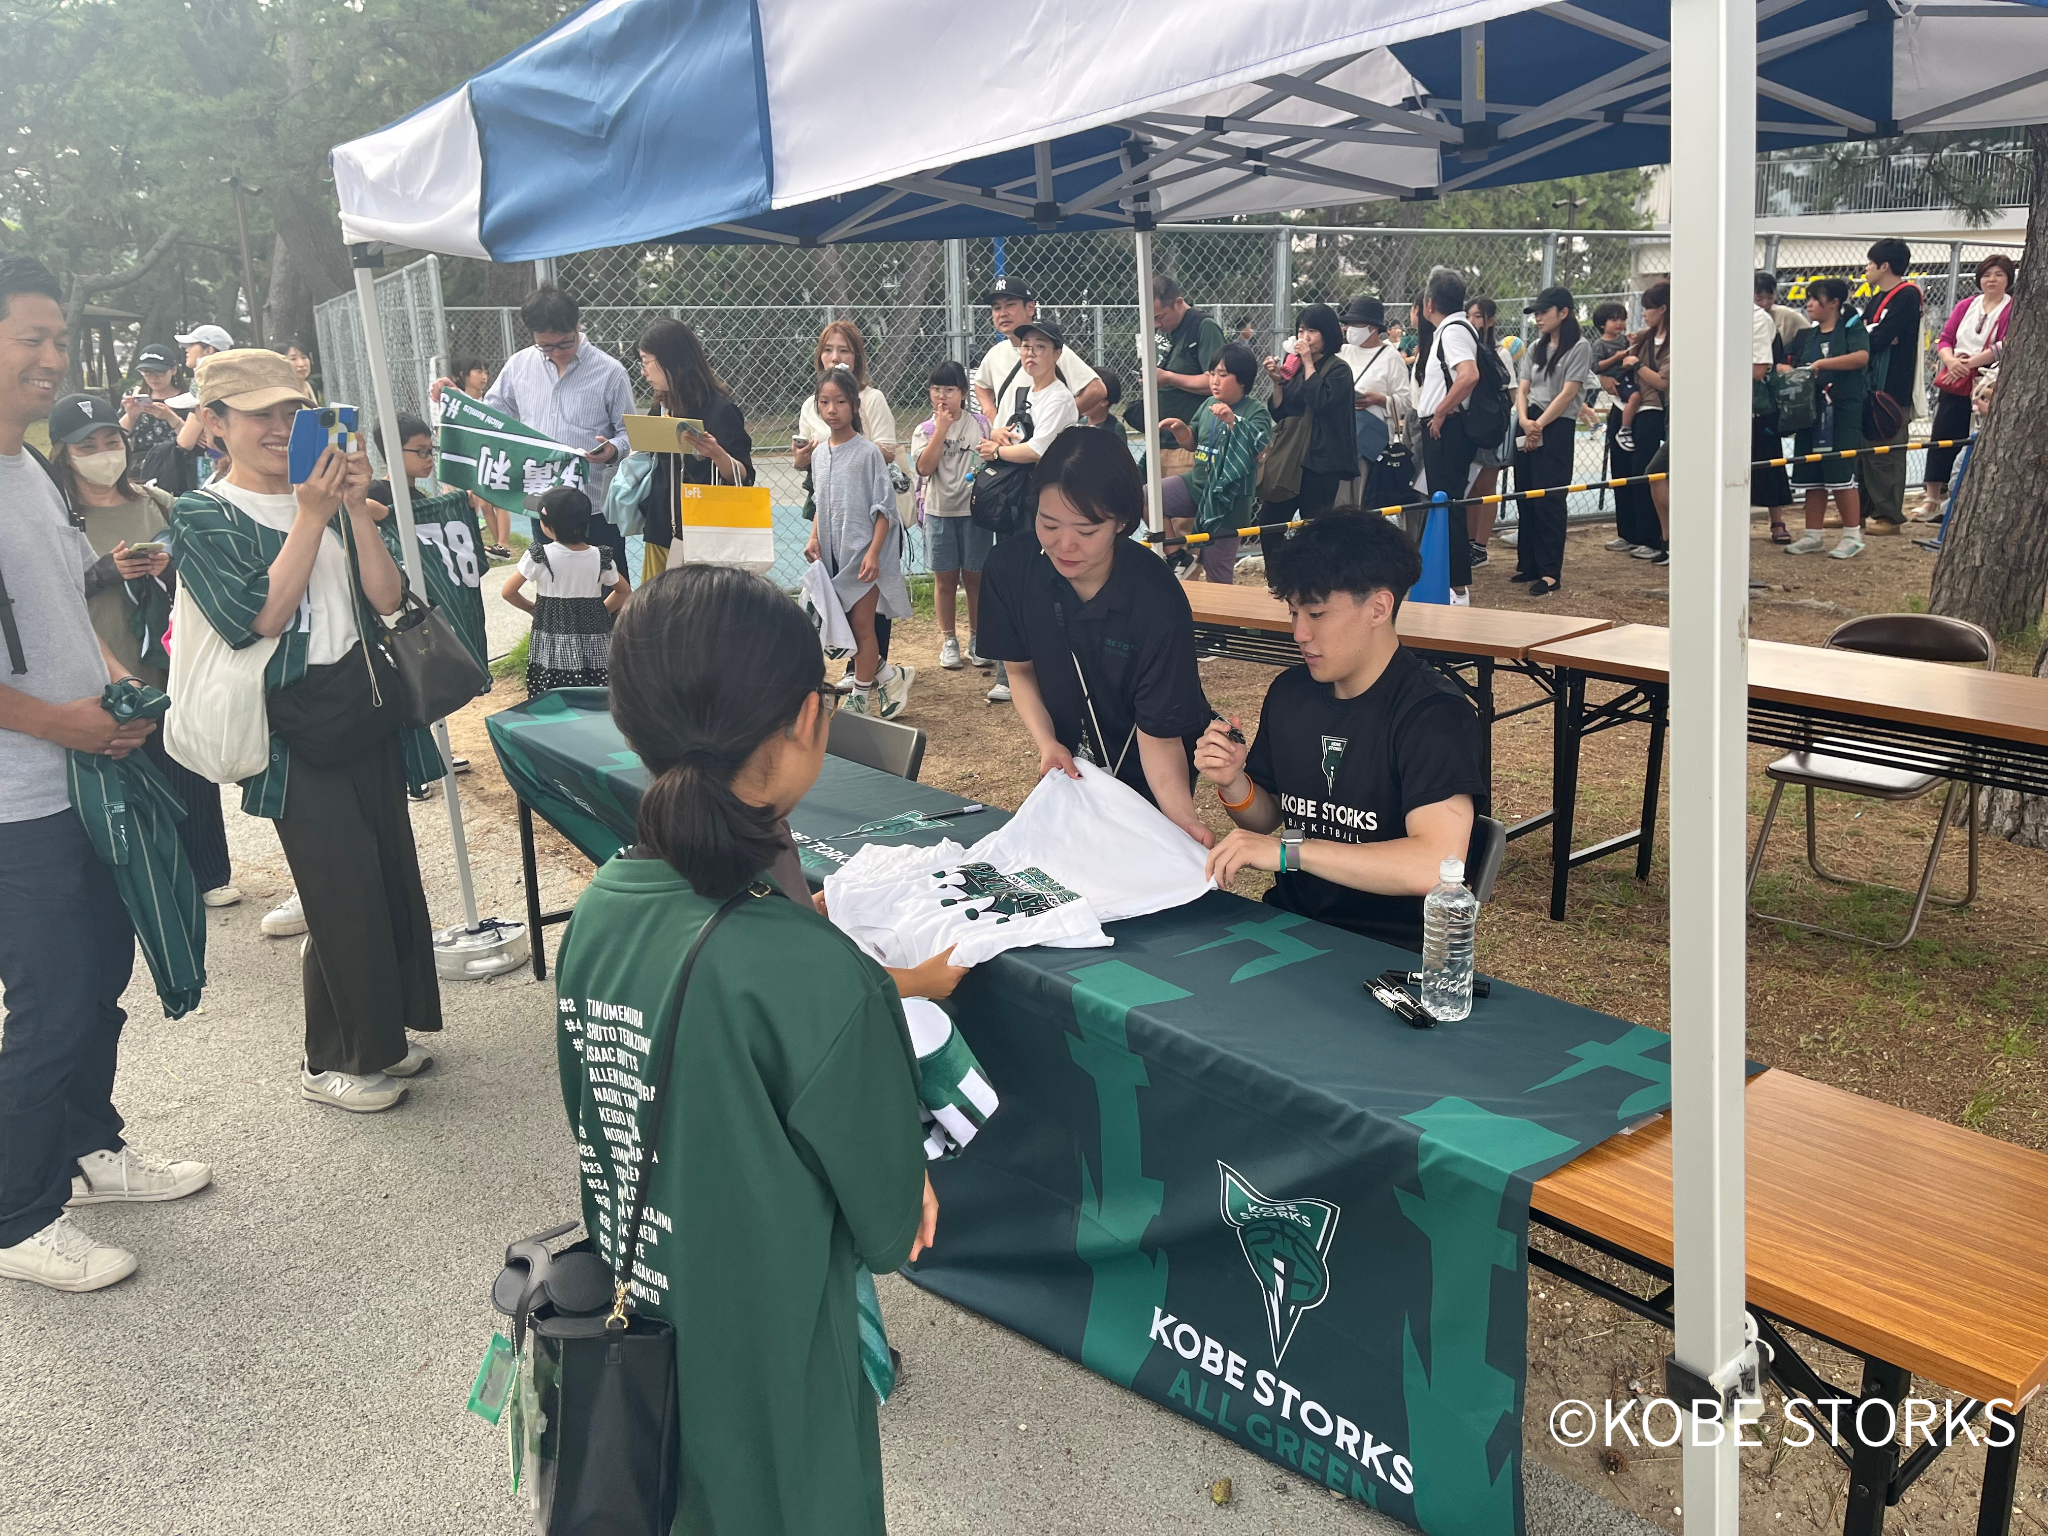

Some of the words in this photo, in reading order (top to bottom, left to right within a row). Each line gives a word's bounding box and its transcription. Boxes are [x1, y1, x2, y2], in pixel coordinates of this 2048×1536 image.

[414, 520, 480, 588] 78
[1281, 792, 1318, 819] KOBE
[1321, 801, 1378, 831] STORKS
[1288, 817, 1362, 844] BASKETBALL
[559, 998, 577, 1013] #2
[602, 1003, 643, 1030] UMEMURA
[564, 1018, 584, 1033] #4
[586, 1021, 617, 1043] SHUTO
[586, 1044, 616, 1063] ISAAC
[616, 1047, 639, 1072] BUTTS
[325, 1076, 354, 1099] N
[588, 1067, 619, 1086] ALLEN
[592, 1086, 623, 1107] NAOKI
[597, 1106, 626, 1127] KEIGO
[581, 1160, 604, 1174] #23
[586, 1178, 609, 1192] #24
[1239, 1211, 1312, 1228] STORKS
[1247, 1202, 1299, 1214] KOBE
[1149, 1306, 1248, 1391] KOBE
[1252, 1369, 1414, 1494] STORKS
[1166, 1368, 1238, 1433] ALL
[1245, 1413, 1379, 1508] GREEN
